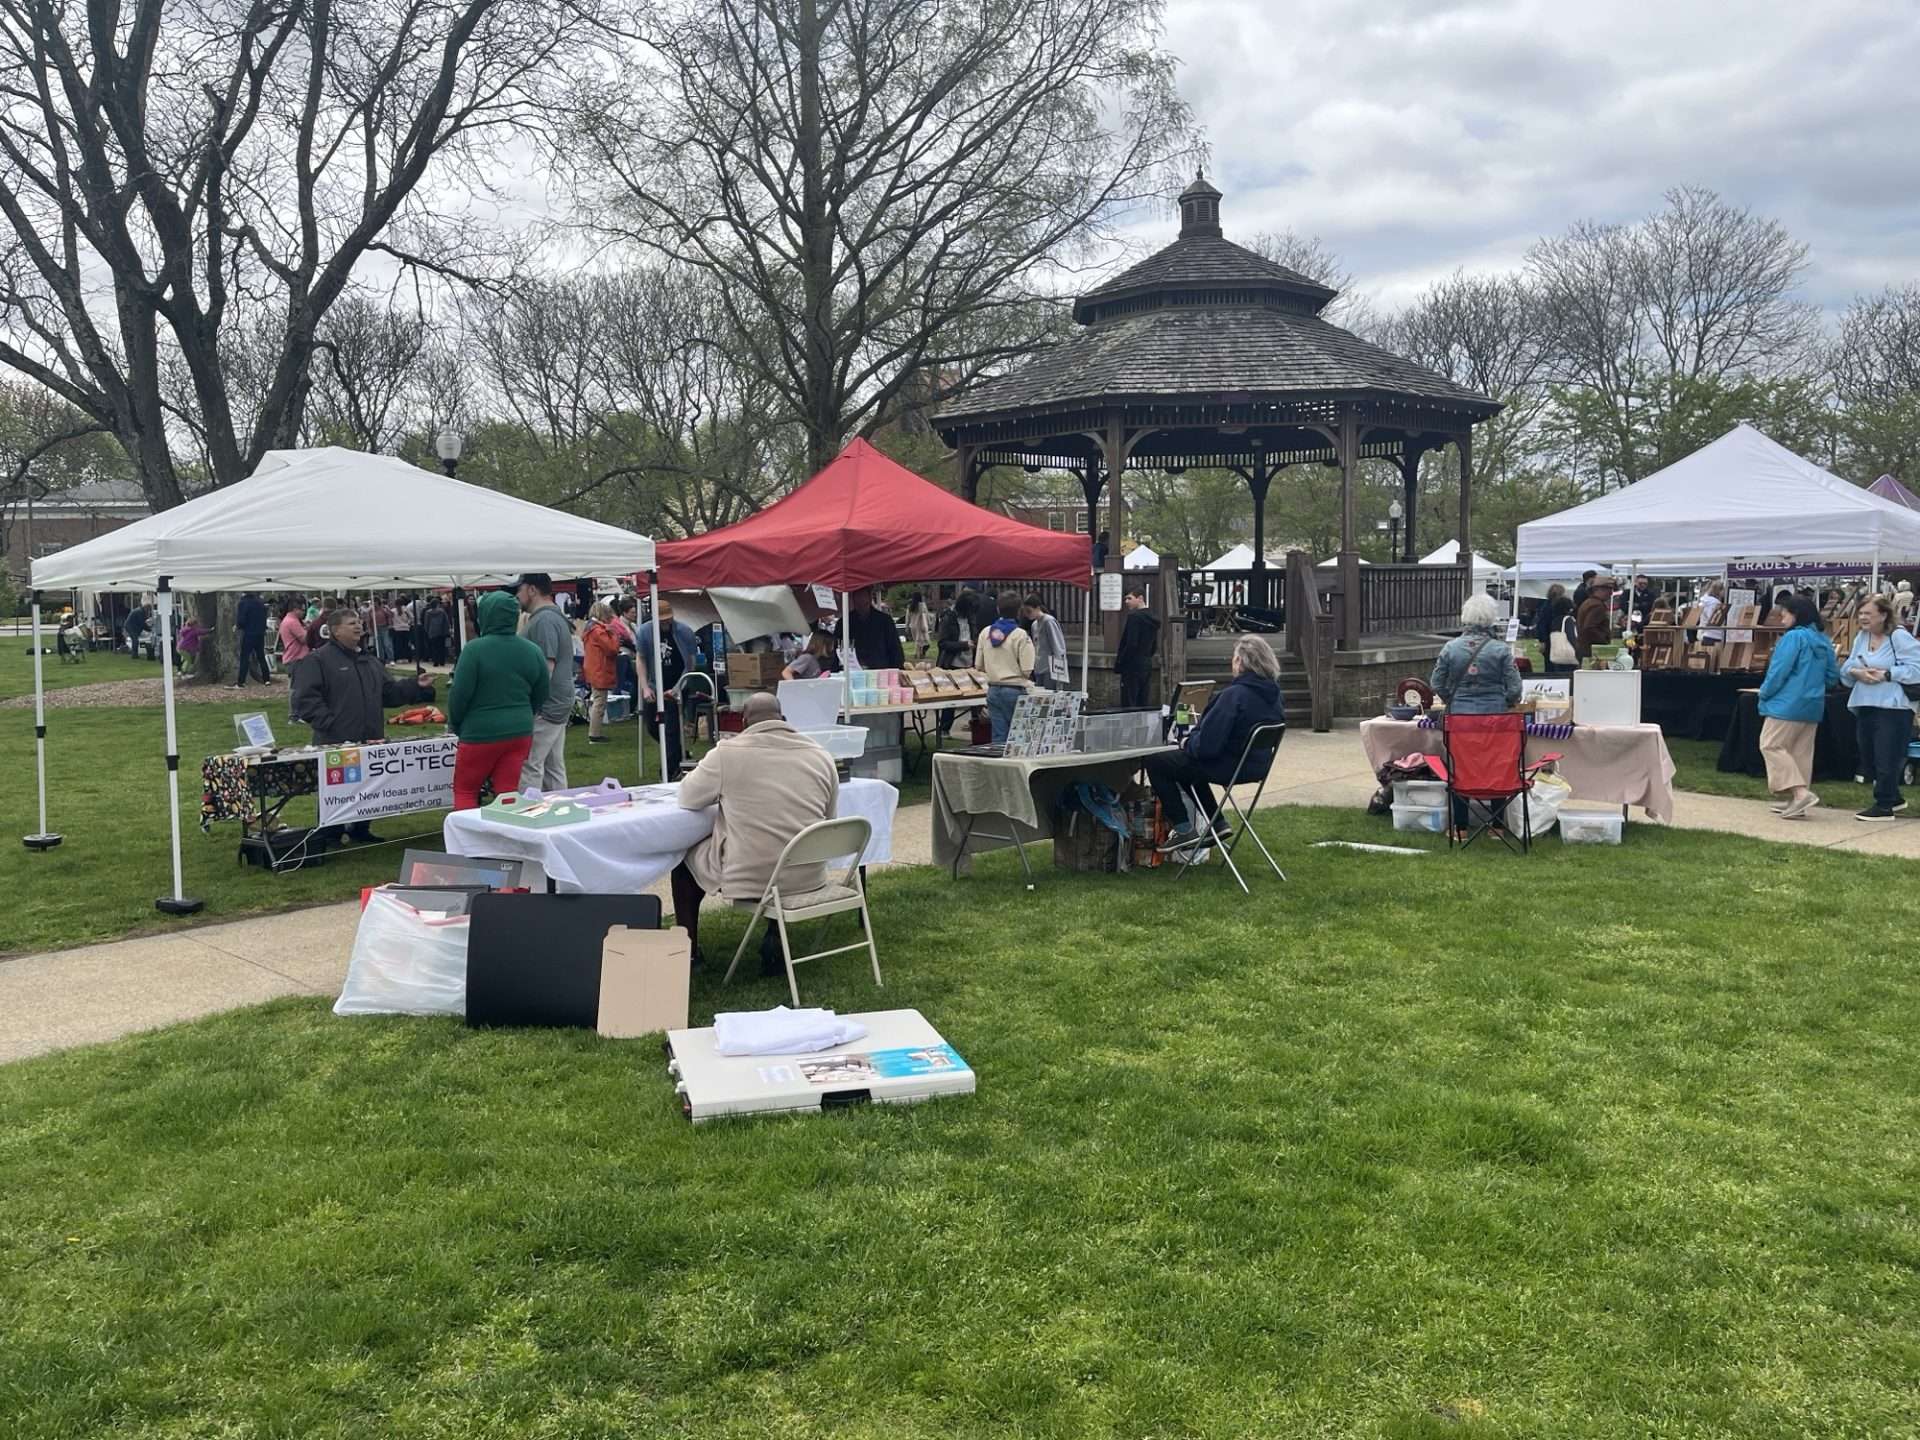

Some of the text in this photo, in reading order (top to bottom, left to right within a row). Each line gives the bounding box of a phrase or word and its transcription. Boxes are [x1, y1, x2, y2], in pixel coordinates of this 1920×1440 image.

[367, 746, 400, 760] NEW
[324, 793, 356, 807] Where
[359, 790, 380, 801] New
[382, 787, 408, 799] Ideas
[410, 785, 426, 794] are
